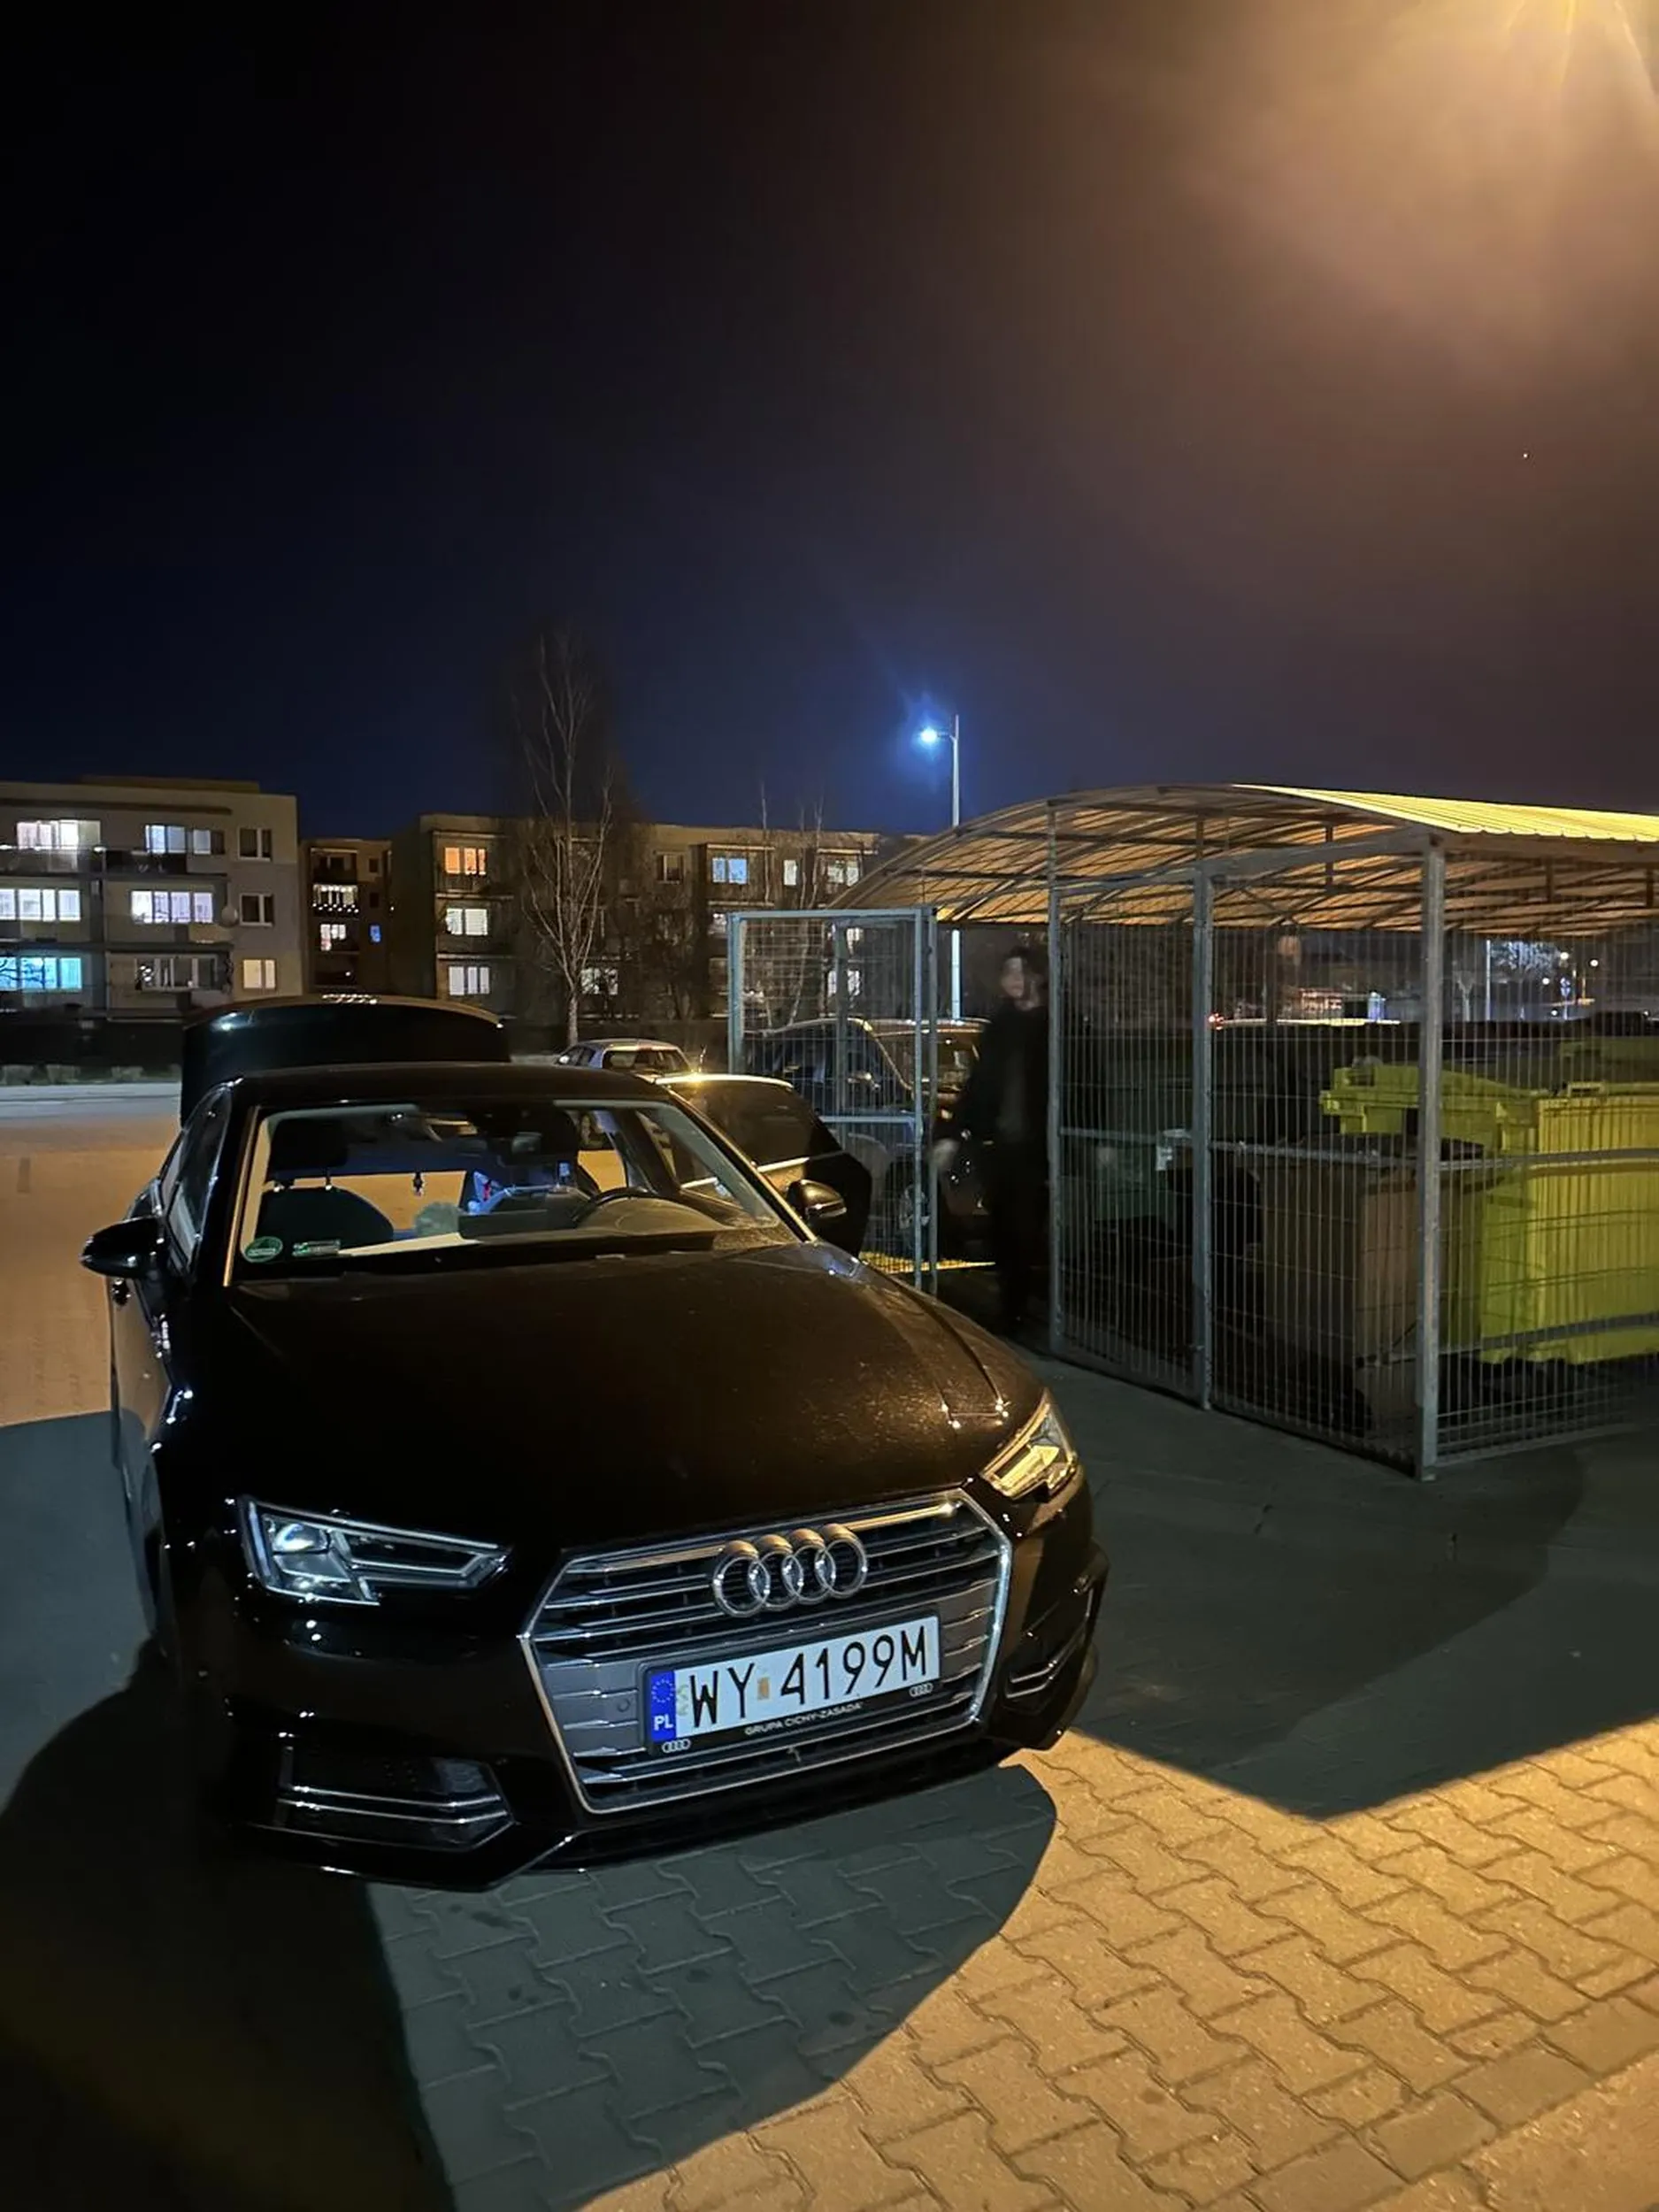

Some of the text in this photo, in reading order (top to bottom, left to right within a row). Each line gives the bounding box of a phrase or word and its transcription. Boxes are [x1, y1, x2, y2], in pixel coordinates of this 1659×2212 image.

[689, 1624, 926, 1728] WY 4199M
[653, 1714, 674, 1732] PL
[744, 1720, 784, 1736] GRUPA
